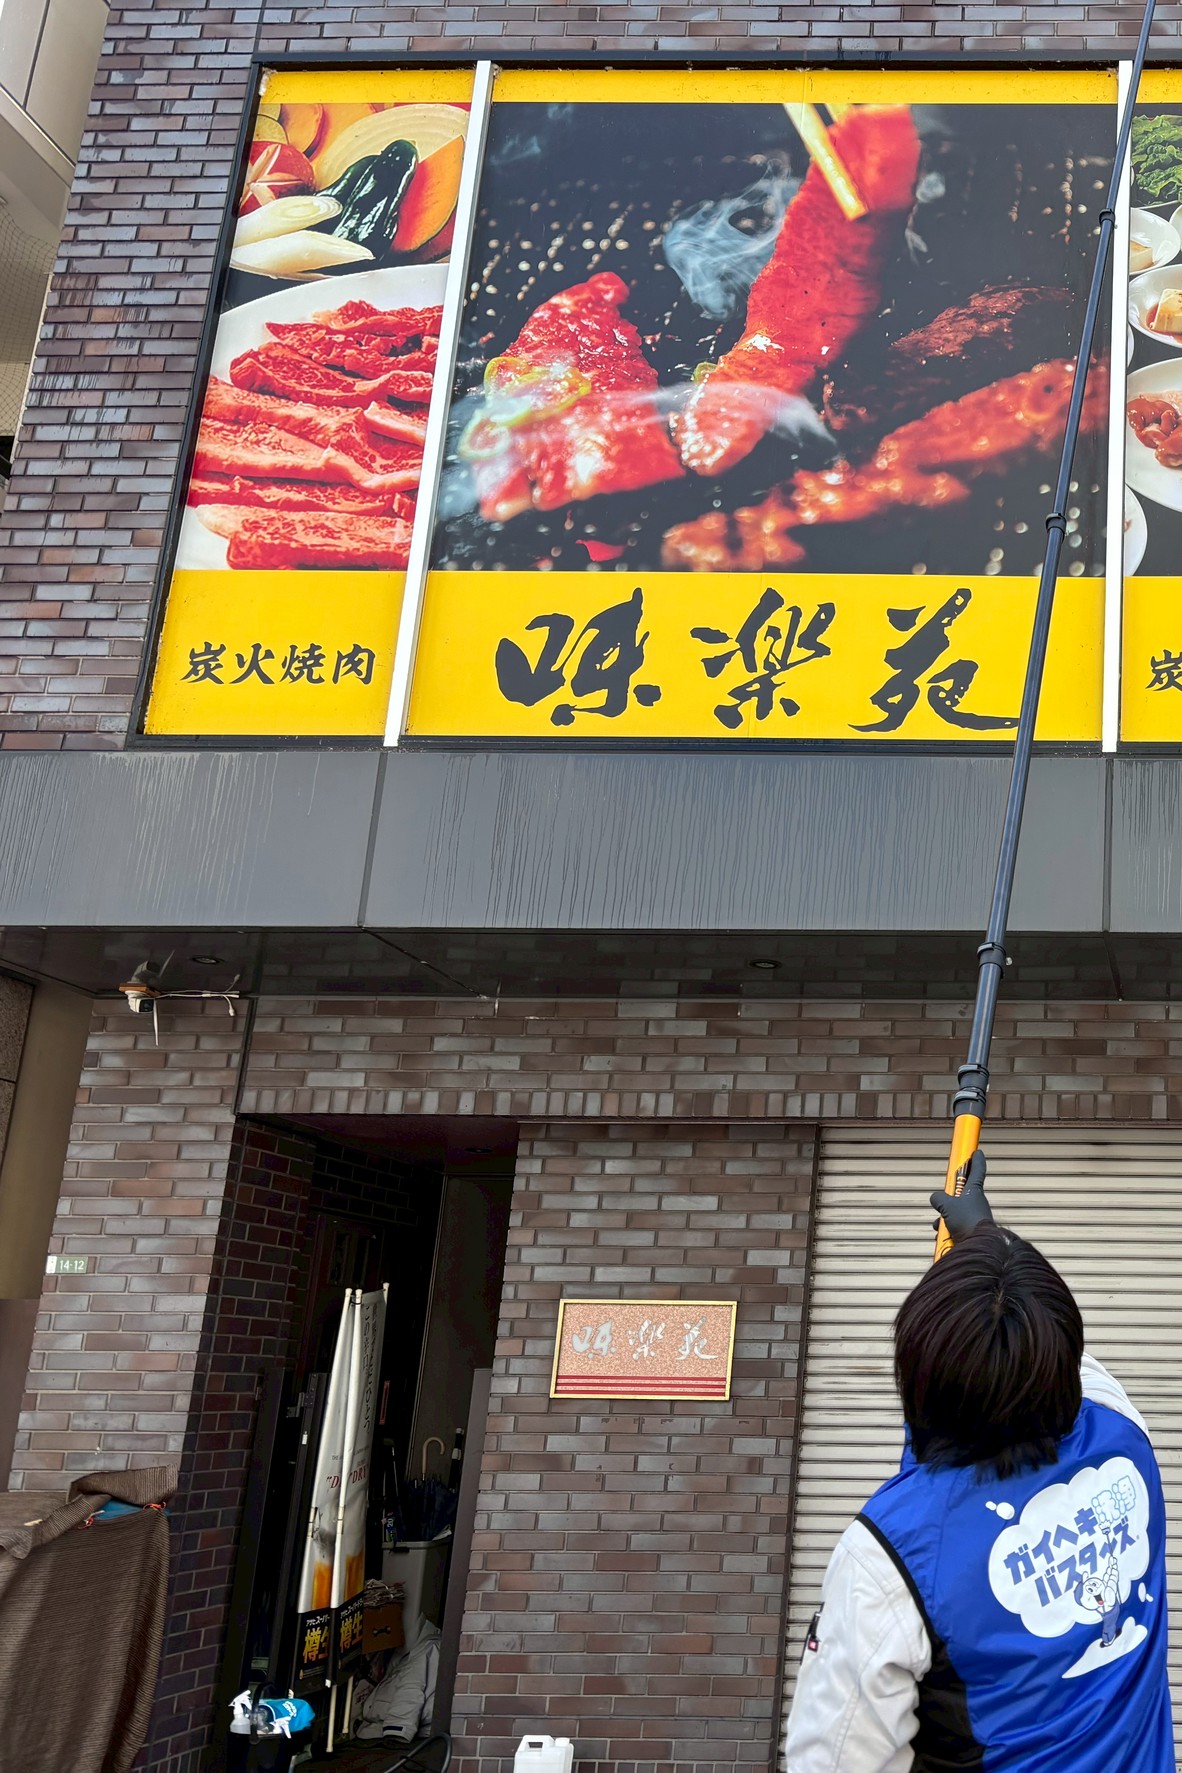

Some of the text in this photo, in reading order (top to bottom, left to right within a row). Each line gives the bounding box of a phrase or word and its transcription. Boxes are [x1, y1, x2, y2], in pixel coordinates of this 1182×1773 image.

[180, 641, 376, 687] 炭火焼肉
[59, 1260, 85, 1271] 14-12
[1034, 1515, 1136, 1608] バスターズ
[340, 1611, 364, 1653] 樽生
